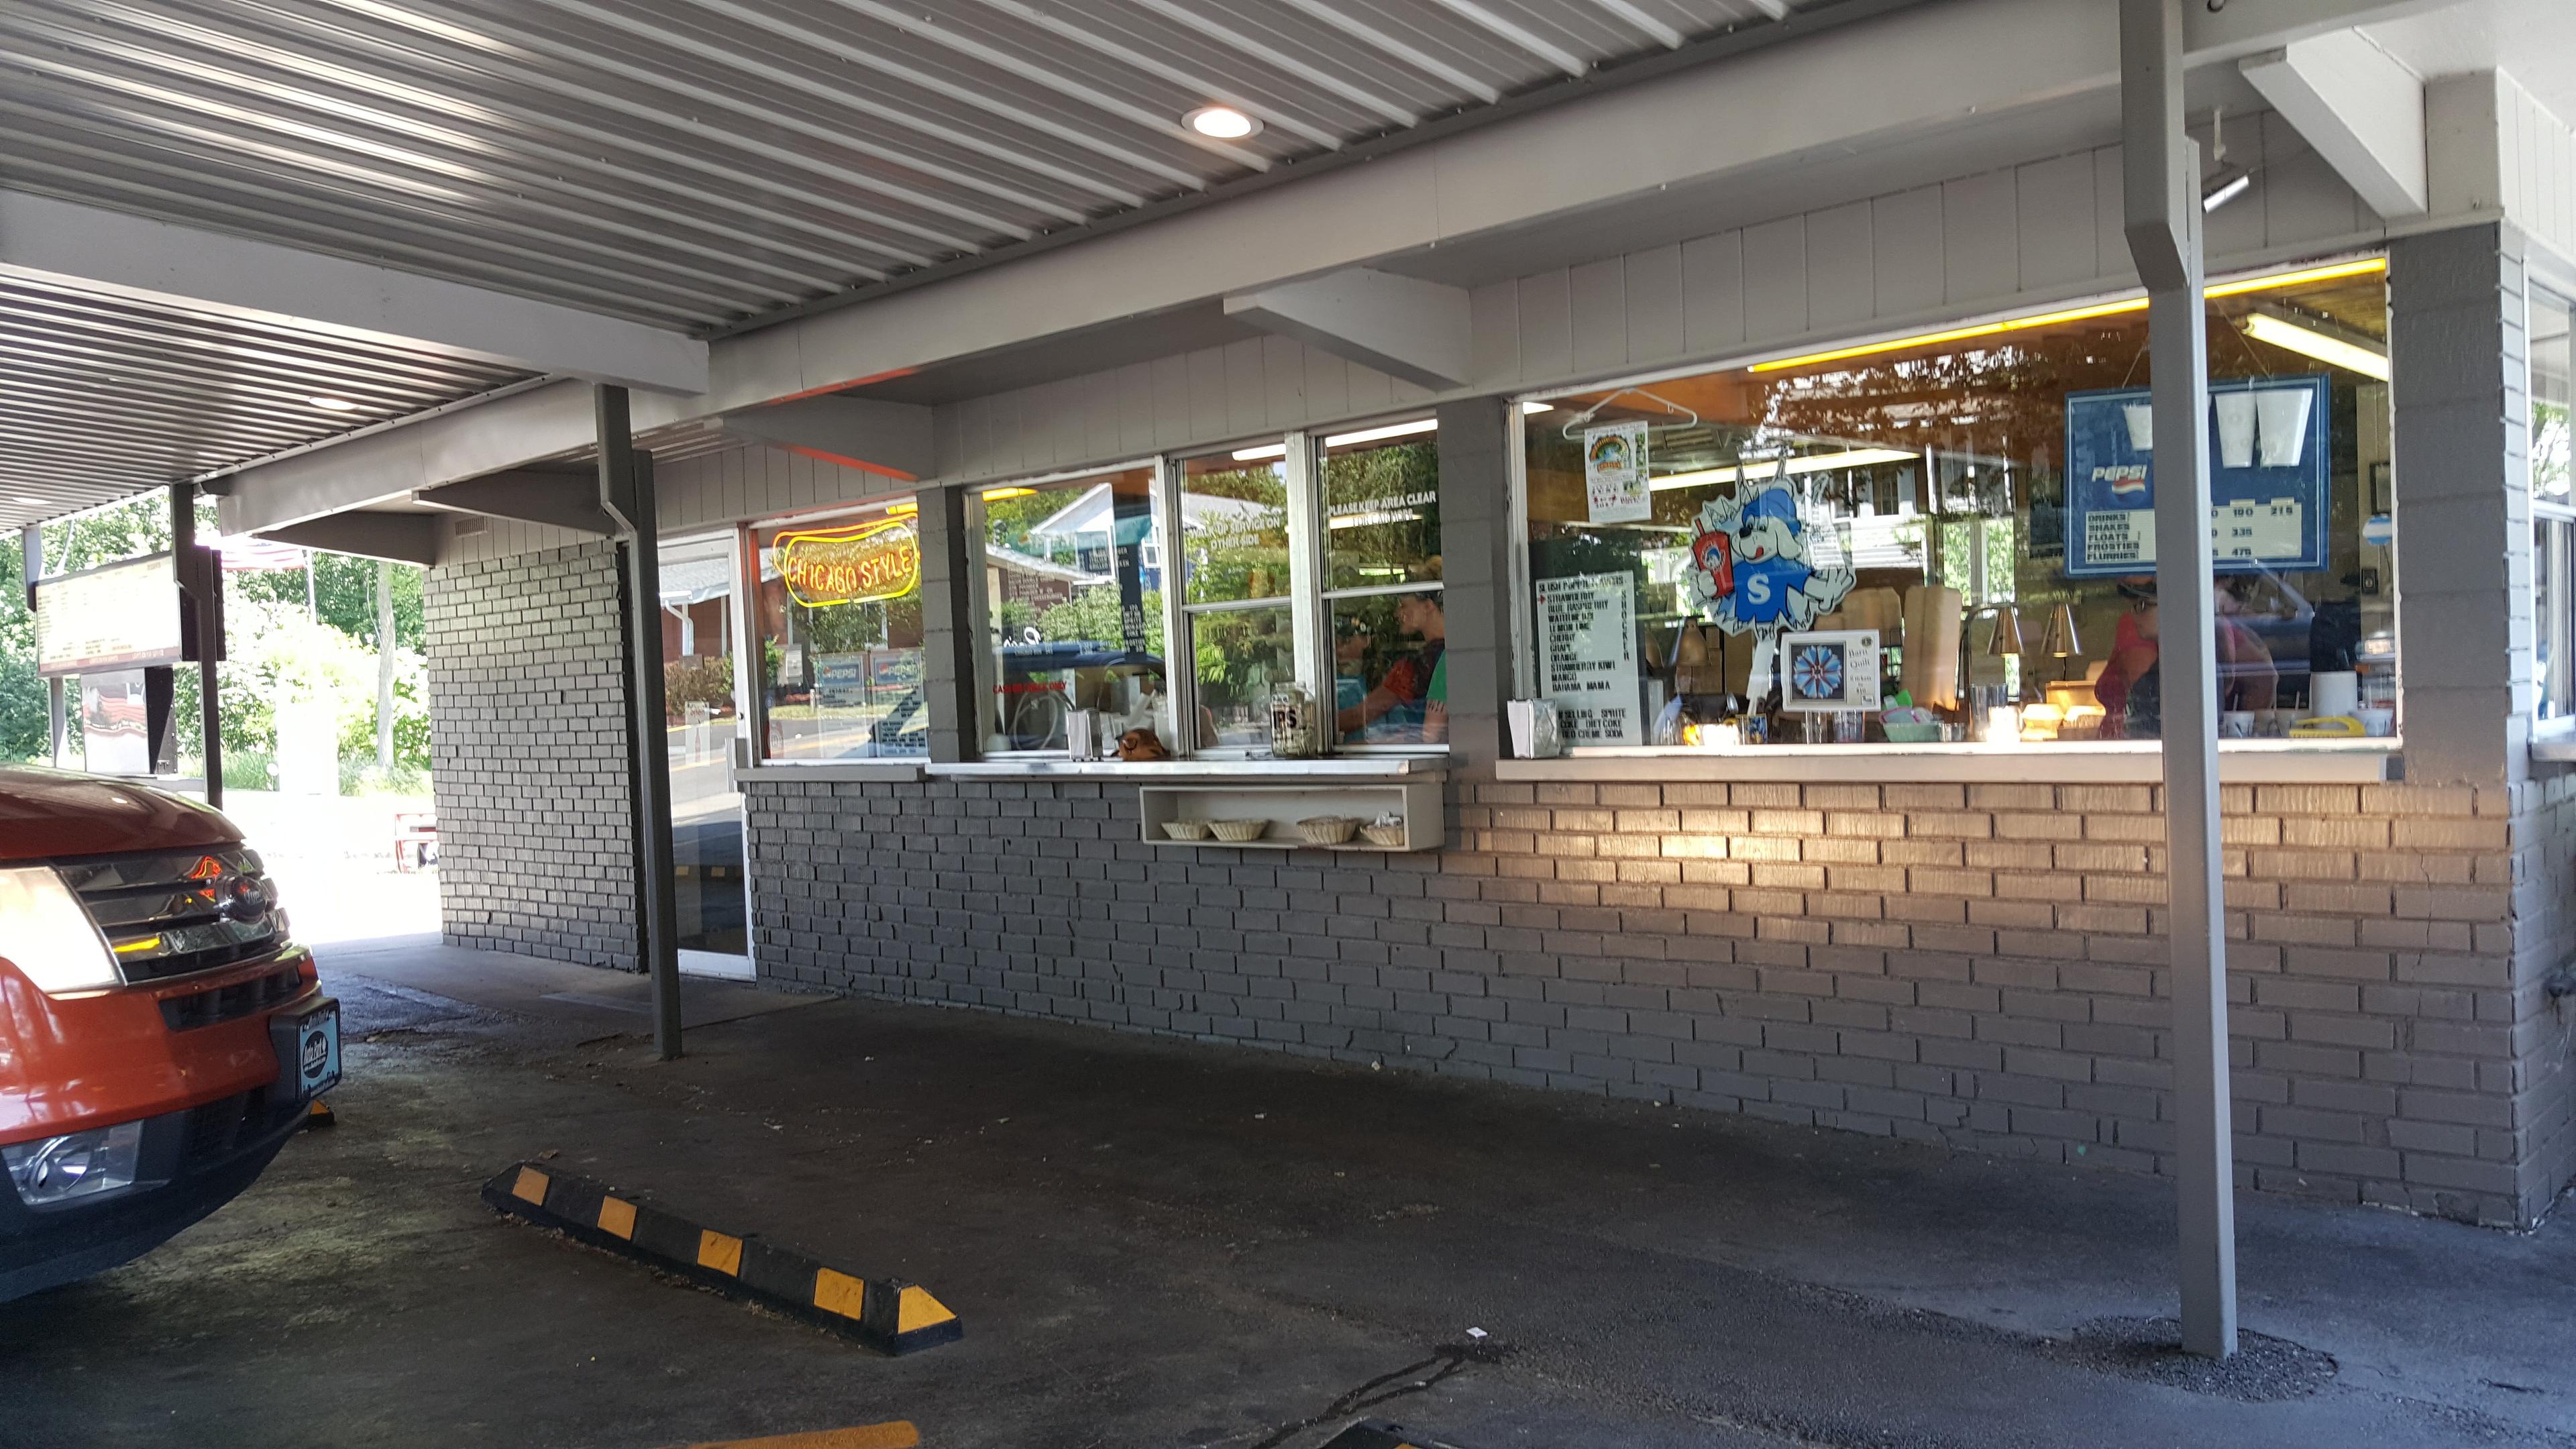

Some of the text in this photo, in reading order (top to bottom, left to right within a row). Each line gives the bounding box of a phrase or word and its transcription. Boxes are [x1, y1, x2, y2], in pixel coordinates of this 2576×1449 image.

[2092, 464, 2147, 482] PEPSI
[1329, 490, 1436, 517] PLEASE KEEP AREA CLEAR
[2088, 514, 2126, 522] DRINKS
[1230, 517, 1265, 535] SERVICE
[1267, 516, 1281, 529] ON
[2088, 524, 2130, 532] SHAKES
[1210, 533, 1260, 550] OTHER SIDE
[2088, 533, 2128, 541] FLOATS
[2087, 543, 2139, 551] FROSTIES
[788, 545, 913, 594] CHICAGO STYLE
[1539, 582, 1561, 592] SLUSH
[1748, 573, 1770, 604] S
[1547, 592, 1595, 604] STRAWBERRY
[1567, 599, 1609, 611] RASPBERRY
[1550, 623, 1573, 633] LEMON
[1550, 633, 1576, 643] CHERRY
[1550, 653, 1577, 662] ORANGE
[1551, 660, 1616, 672] STRAWBERRY KIWI
[1551, 672, 1577, 682] MANGO
[1049, 680, 1067, 690] ONLY
[1552, 680, 1611, 692] BAHAMA MAMA
[1601, 708, 1626, 718] SPRITE
[1585, 718, 1602, 729] DIET
[1603, 718, 1622, 728] COKE
[1605, 729, 1623, 739] SODA
